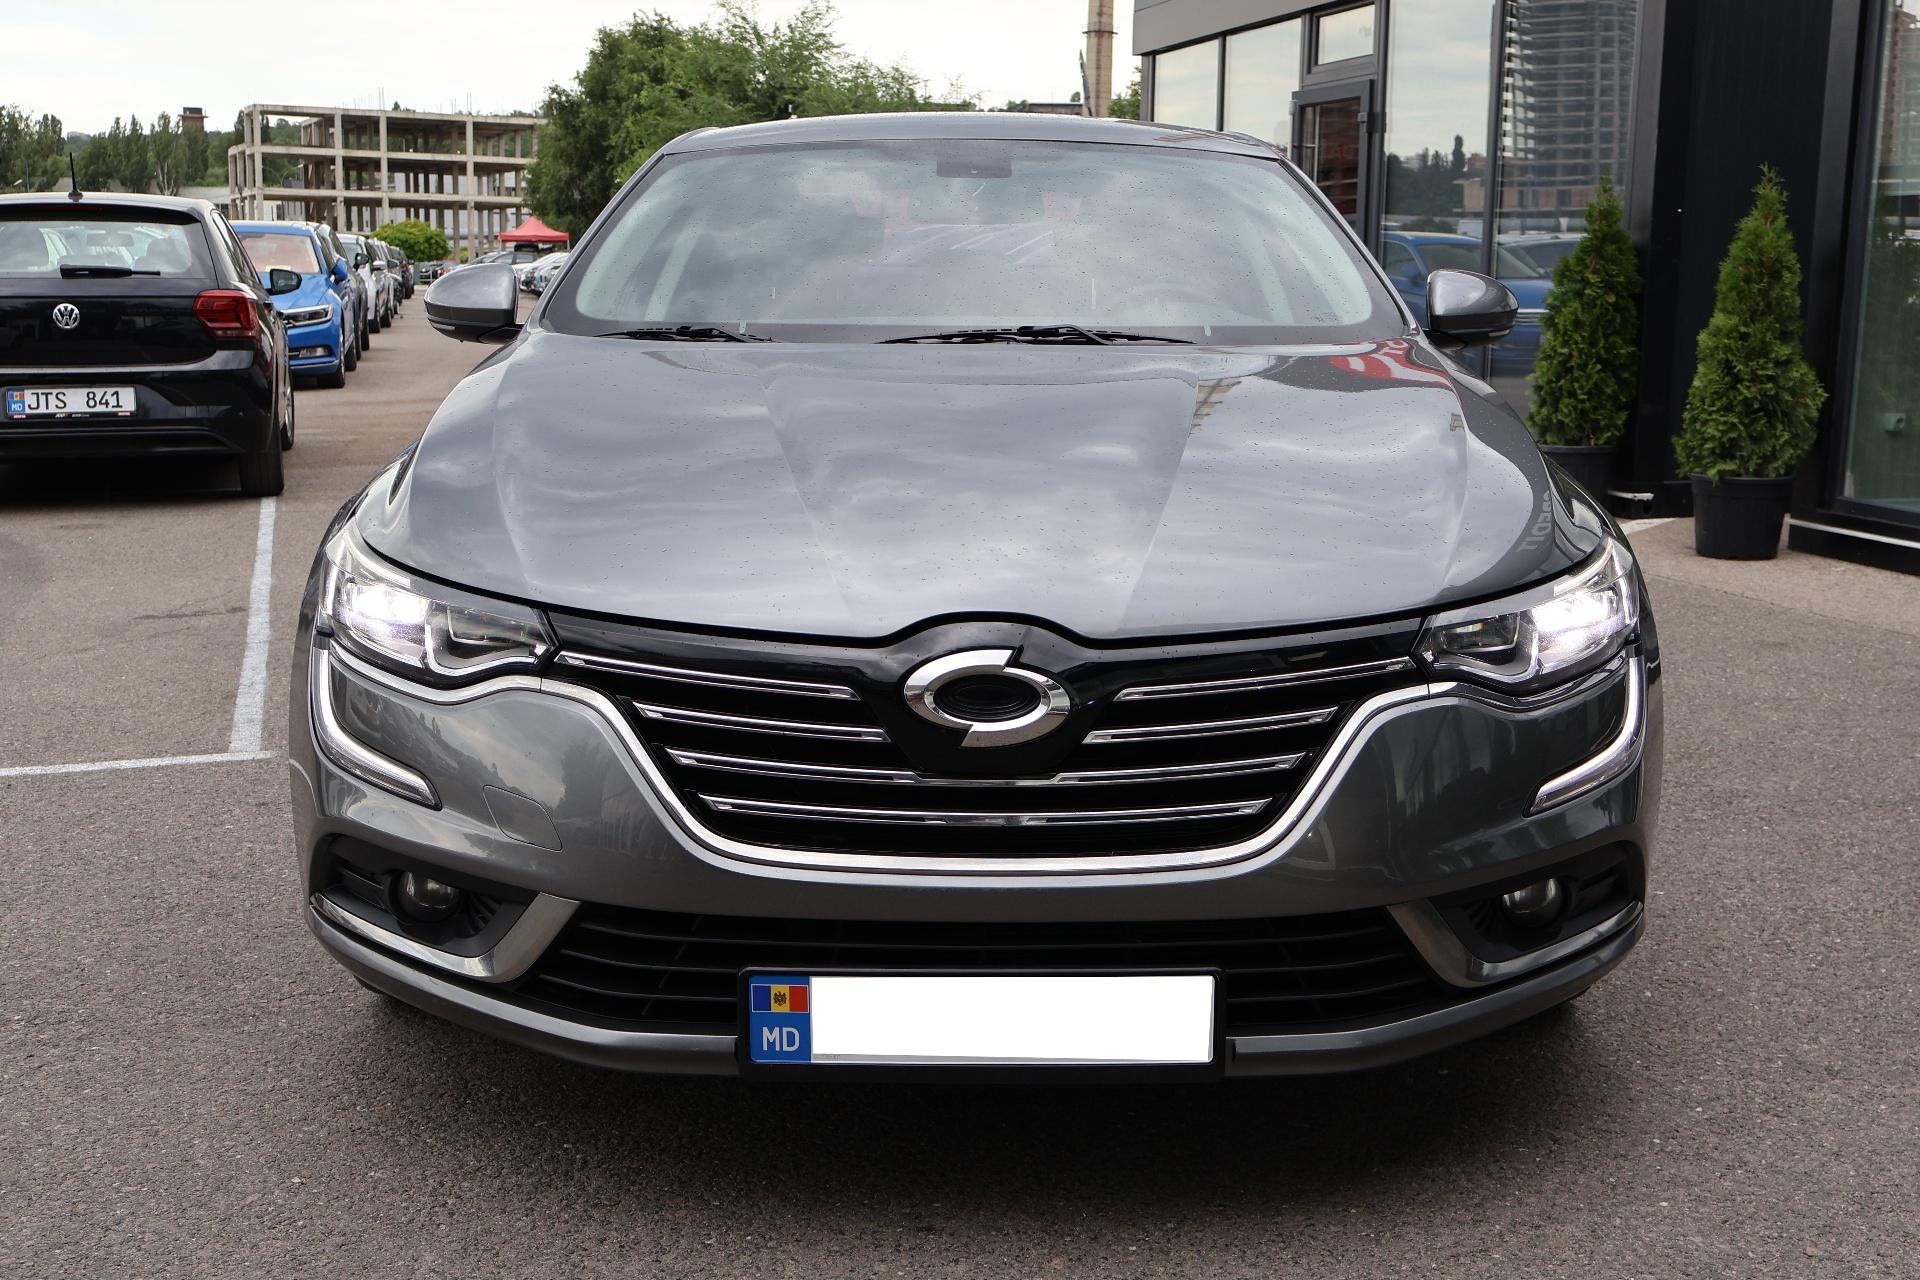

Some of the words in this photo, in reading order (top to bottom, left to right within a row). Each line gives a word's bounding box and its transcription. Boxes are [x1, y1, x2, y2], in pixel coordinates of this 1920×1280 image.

[11, 403, 23, 411] MD
[28, 392, 67, 410] JTS
[86, 390, 123, 408] 841
[762, 1026, 800, 1051] MD
